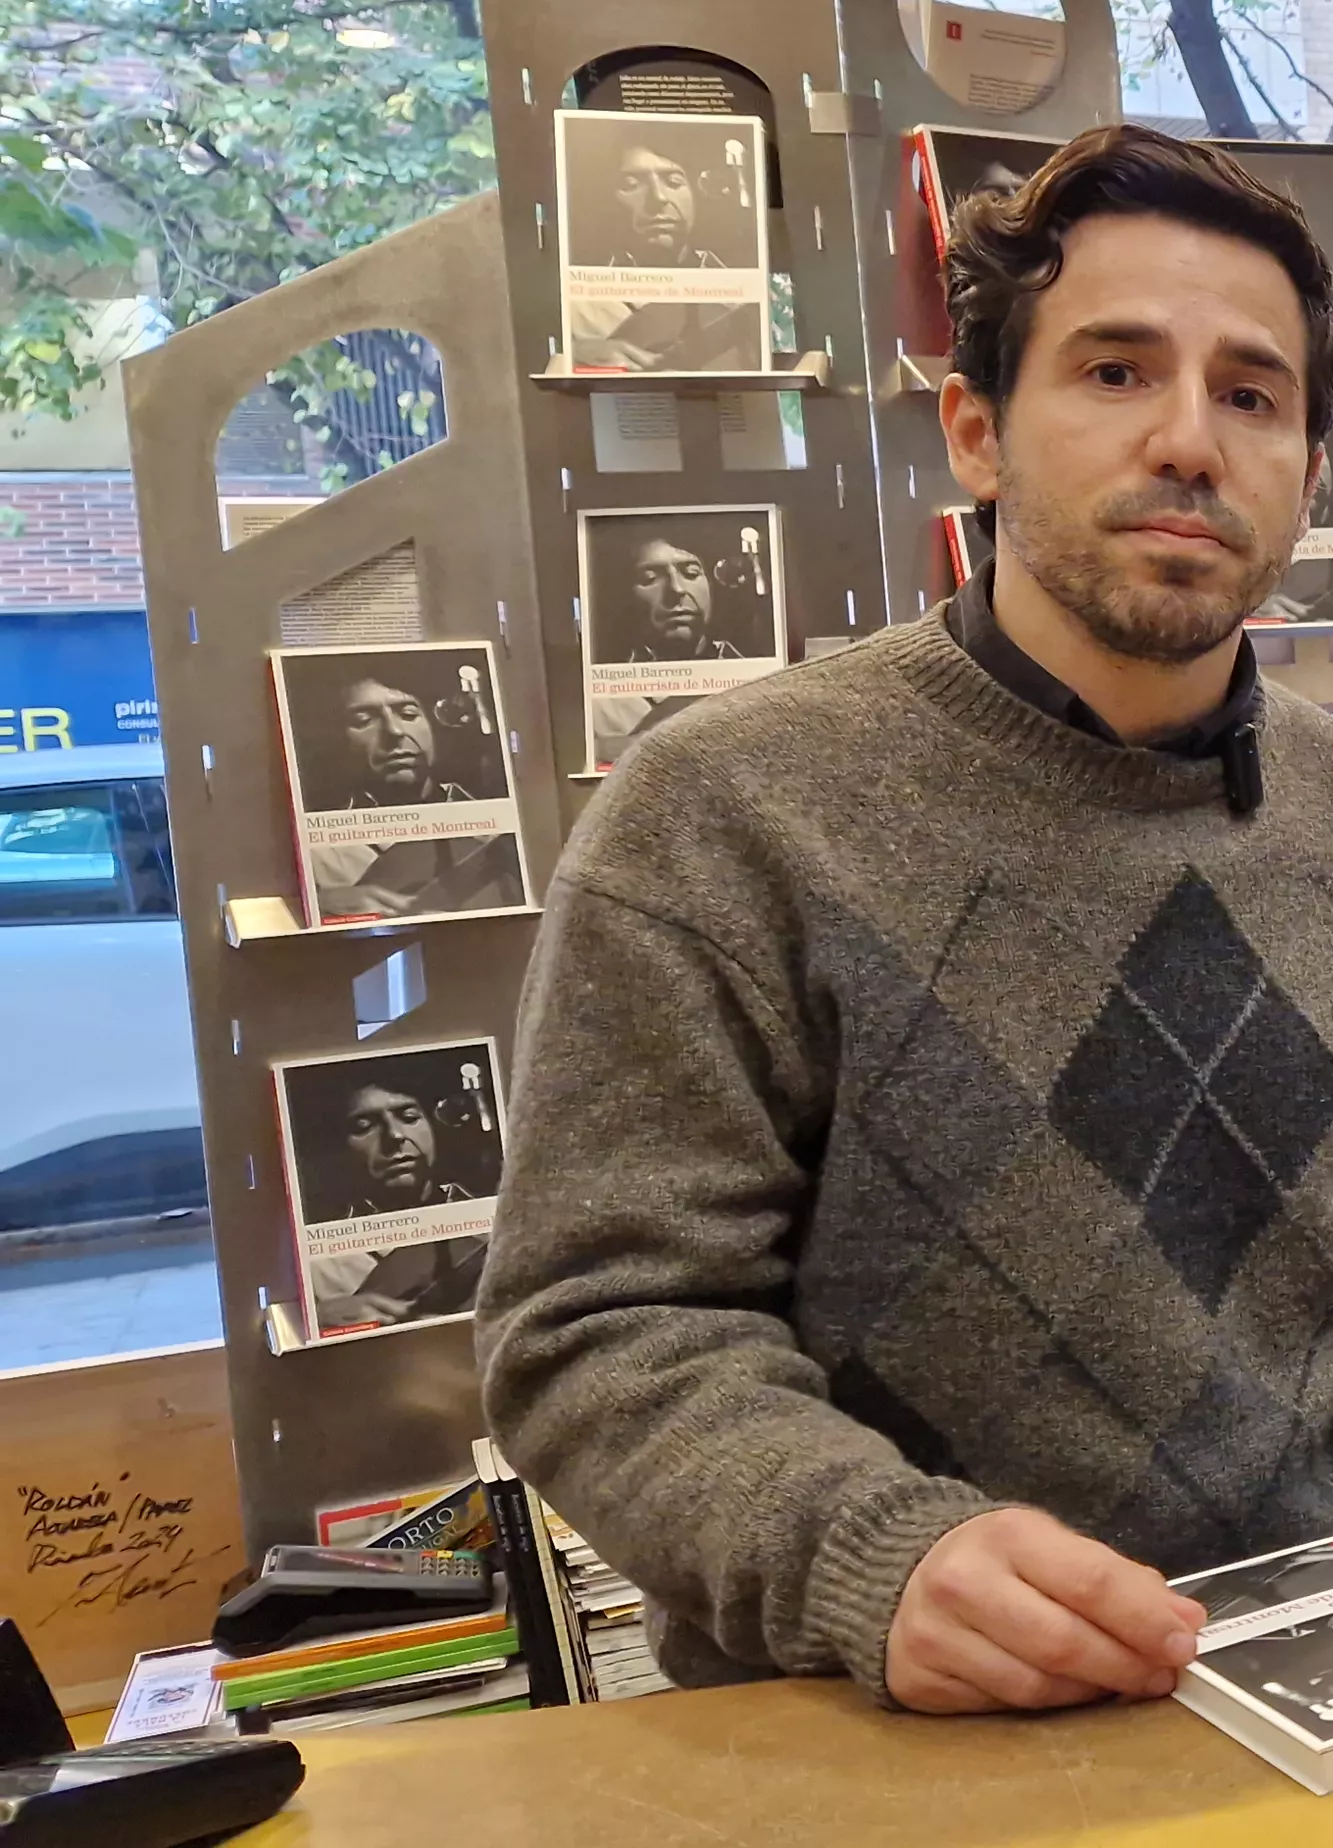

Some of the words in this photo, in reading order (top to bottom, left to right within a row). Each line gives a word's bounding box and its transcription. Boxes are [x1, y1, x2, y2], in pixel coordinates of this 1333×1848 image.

[569, 270, 616, 284] Miguel
[620, 270, 674, 283] Barrero
[569, 285, 584, 297] El
[588, 285, 661, 299] guitarrista
[664, 285, 680, 297] de
[684, 286, 744, 298] Montreal
[1311, 544, 1325, 555] de
[591, 667, 637, 681] Miguel
[641, 666, 693, 679] Barrero
[592, 682, 606, 694] El
[609, 680, 680, 694] guitarrista
[683, 679, 699, 690] de
[306, 814, 358, 829] Miguel
[362, 811, 420, 826] Barrero
[308, 831, 325, 844] El
[328, 826, 408, 844] guitarrista
[411, 823, 428, 836] de
[432, 818, 497, 834] Montreal
[306, 1222, 357, 1242] Miguel
[362, 1214, 420, 1233] Barrero
[308, 1242, 324, 1256] El
[328, 1232, 407, 1254] guitarrista
[411, 1226, 428, 1239] de
[1194, 1598, 1313, 1640] Montreal
